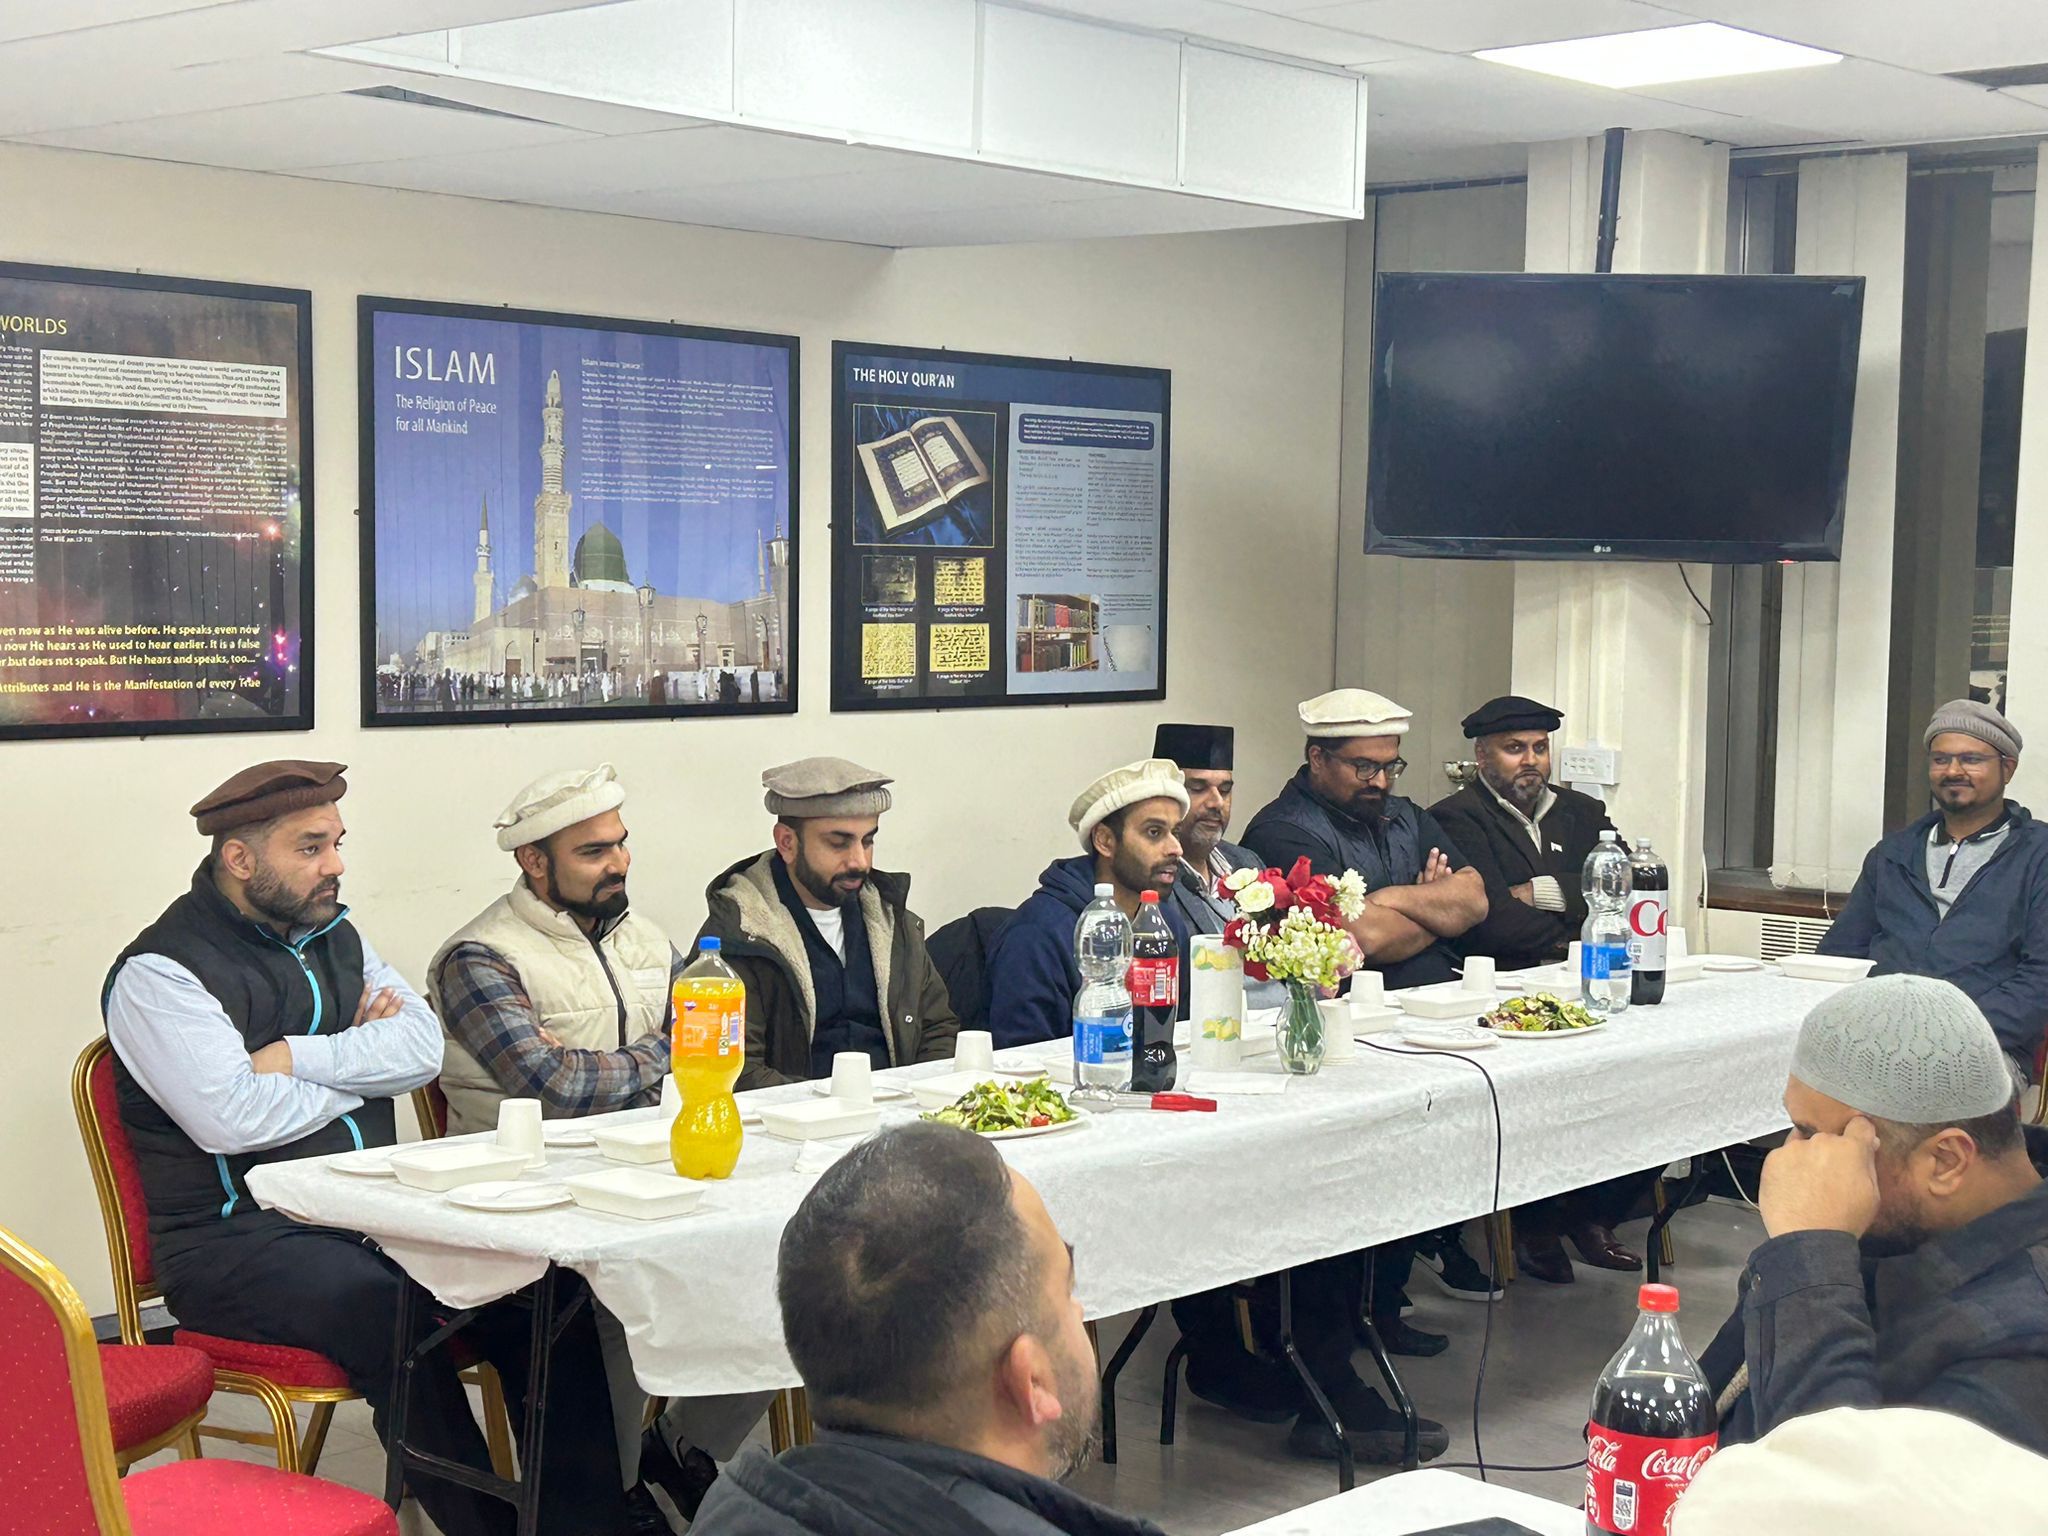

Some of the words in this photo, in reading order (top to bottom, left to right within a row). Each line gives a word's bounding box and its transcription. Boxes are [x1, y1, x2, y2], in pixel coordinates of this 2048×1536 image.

[395, 345, 495, 385] ISLAM
[852, 367, 876, 383] THE
[878, 369, 909, 385] HOLY
[911, 372, 955, 388] QUR'AN
[395, 393, 414, 409] The
[415, 395, 455, 414] Religion
[457, 397, 467, 412] of
[469, 398, 497, 414] Peace
[396, 416, 410, 432] for
[411, 418, 424, 432] all
[426, 418, 468, 434] Mankind
[18, 627, 42, 636] now
[43, 627, 55, 636] as
[58, 625, 73, 635] He
[74, 627, 96, 635] was
[97, 625, 122, 635] alive
[124, 624, 161, 635] before.
[163, 625, 176, 635] He
[178, 624, 212, 636] speaks
[214, 626, 237, 635] even
[239, 625, 260, 635] now
[4, 642, 28, 651] now
[29, 641, 45, 651] He
[46, 640, 76, 651] hears
[78, 641, 90, 651] as
[92, 640, 107, 650] He
[109, 640, 133, 650] used
[135, 641, 146, 649] to
[148, 640, 171, 649] hear
[173, 640, 208, 650] earlier.
[209, 639, 218, 649] It
[219, 639, 228, 649] is
[229, 641, 235, 649] a
[237, 638, 261, 649] false
[7, 656, 27, 666] but
[28, 656, 54, 666] does
[55, 657, 73, 666] not
[75, 655, 108, 667] speak.
[109, 655, 127, 666] But
[128, 655, 143, 665] He
[144, 655, 172, 664] hears
[173, 654, 193, 664] and
[193, 654, 229, 666] speaks,
[52, 681, 73, 692] and
[75, 681, 90, 691] He
[92, 680, 101, 691] is
[104, 680, 122, 691] the
[124, 679, 193, 690] Manifestation
[196, 677, 207, 689] of
[208, 679, 236, 690] every
[239, 677, 261, 688] True
